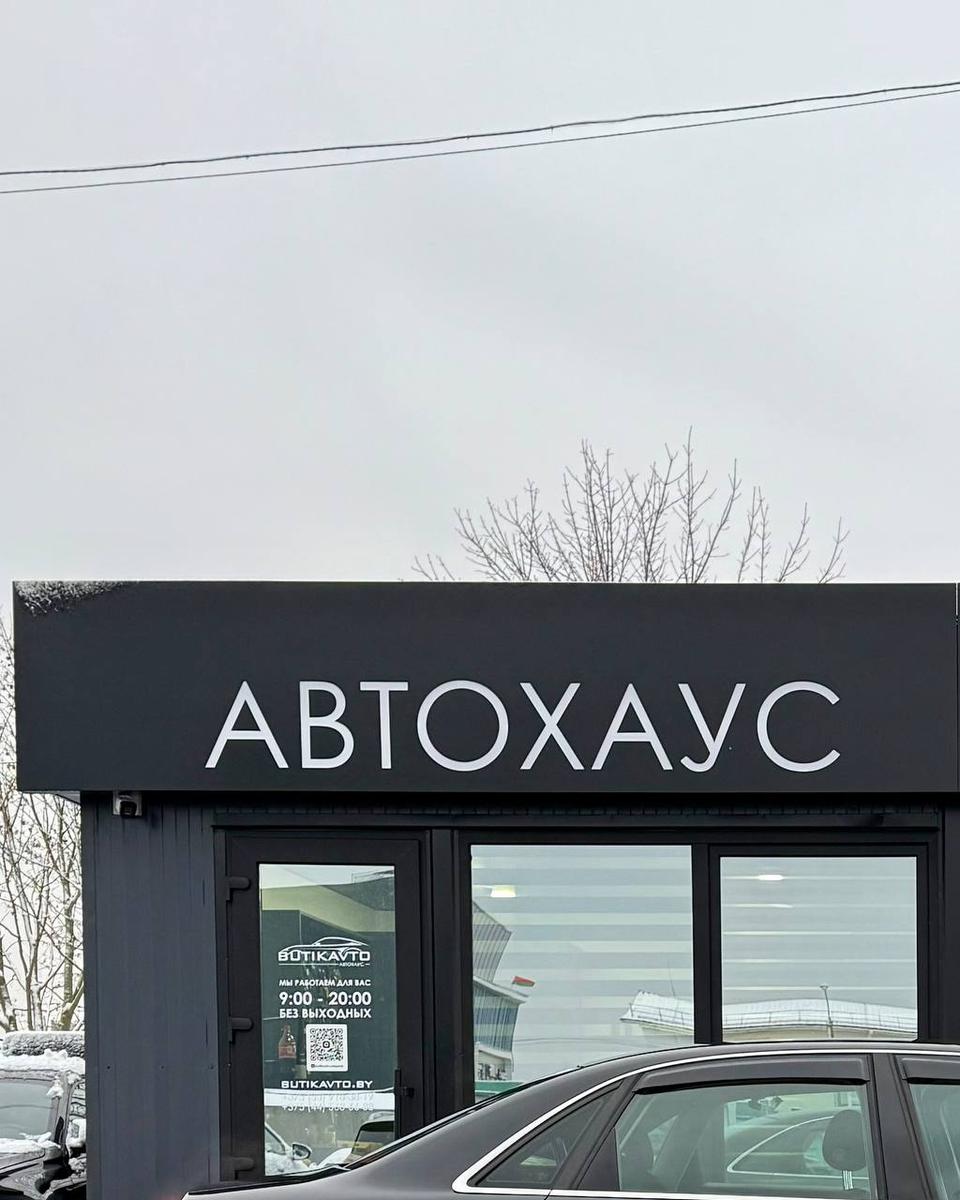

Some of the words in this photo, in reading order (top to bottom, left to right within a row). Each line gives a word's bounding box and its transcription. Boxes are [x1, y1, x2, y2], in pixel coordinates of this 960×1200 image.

[205, 680, 841, 773] АВТОХАУС
[278, 951, 371, 962] BUTIKAVTO
[279, 979, 293, 987] МЫ
[294, 979, 336, 987] РАБОТАЕМ
[336, 979, 353, 988] ДЛЯ
[354, 979, 371, 987] ВАС
[279, 991, 312, 1006] 9:00
[328, 991, 372, 1006] 20:00
[279, 1008, 299, 1019] БЕЗ
[301, 1008, 372, 1020] ВЫХОДНЫХ
[281, 1080, 373, 1089] BUTIKAVTO.BY
